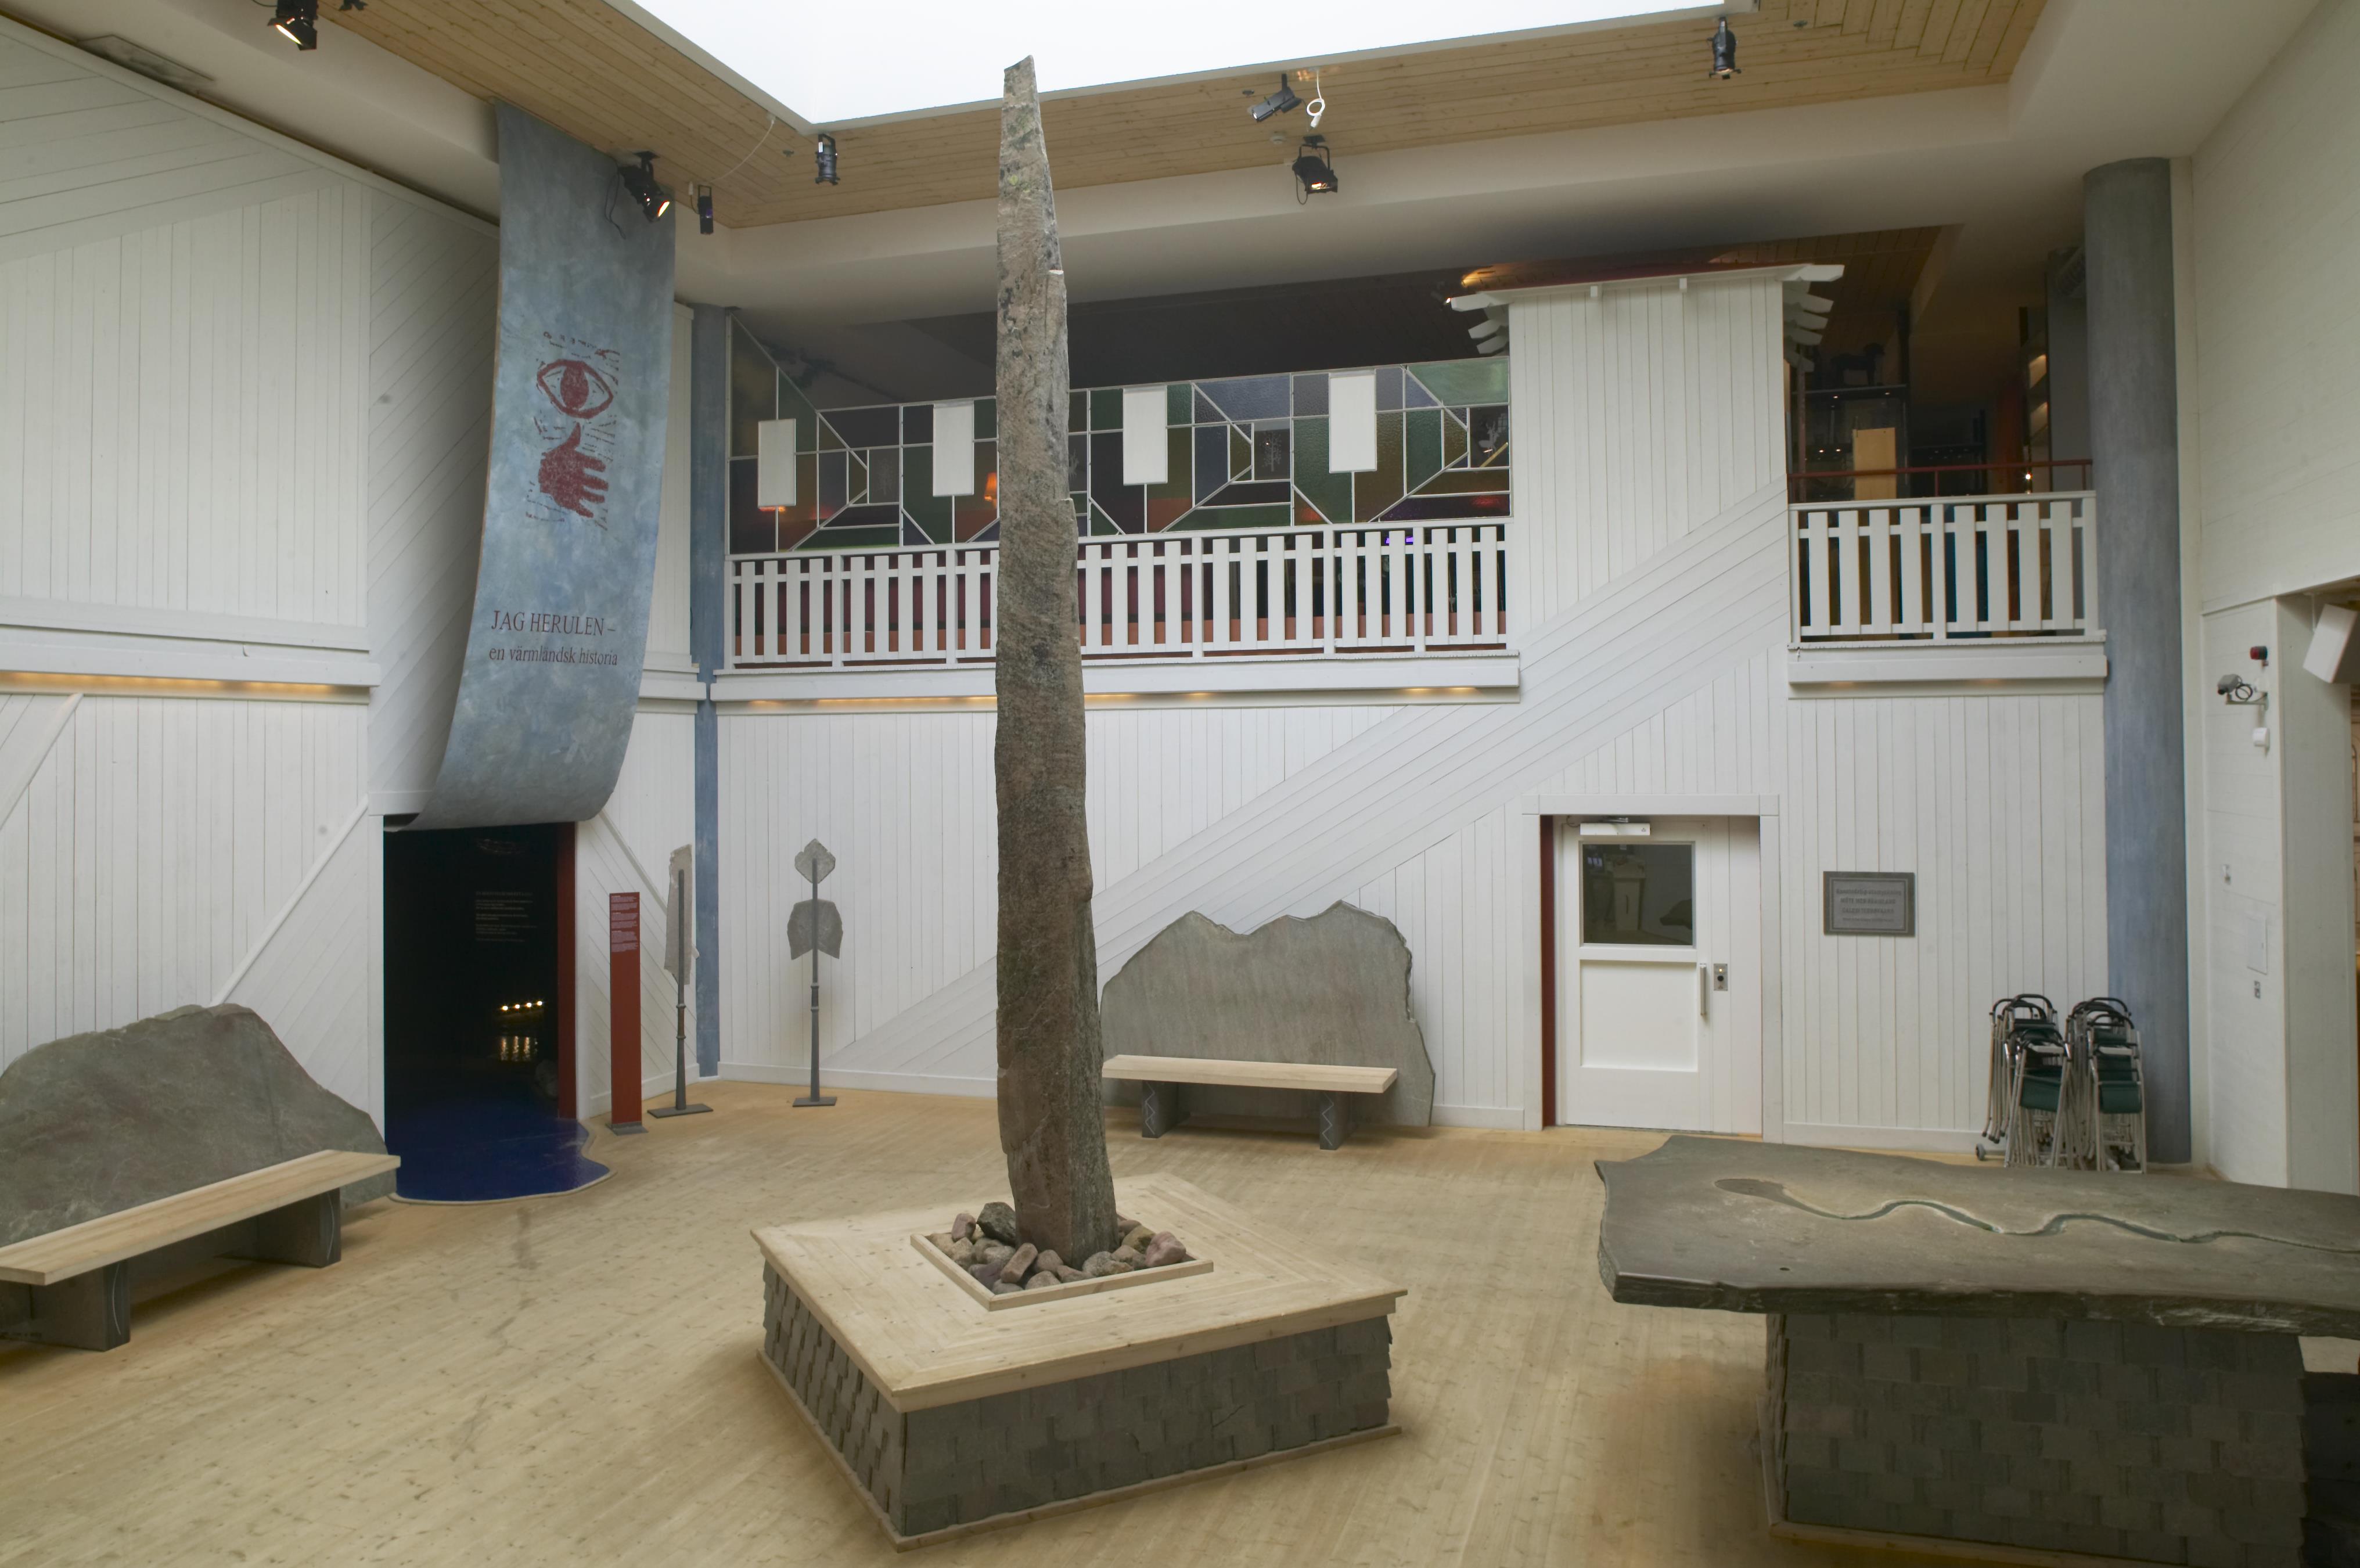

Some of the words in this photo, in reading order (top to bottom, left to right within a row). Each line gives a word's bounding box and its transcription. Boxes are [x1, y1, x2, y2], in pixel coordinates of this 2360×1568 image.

[491, 610, 525, 631] JAG
[530, 613, 604, 636] HERULEN
[489, 648, 505, 661] en
[510, 645, 577, 664] värmländsk
[580, 648, 618, 666] historia
